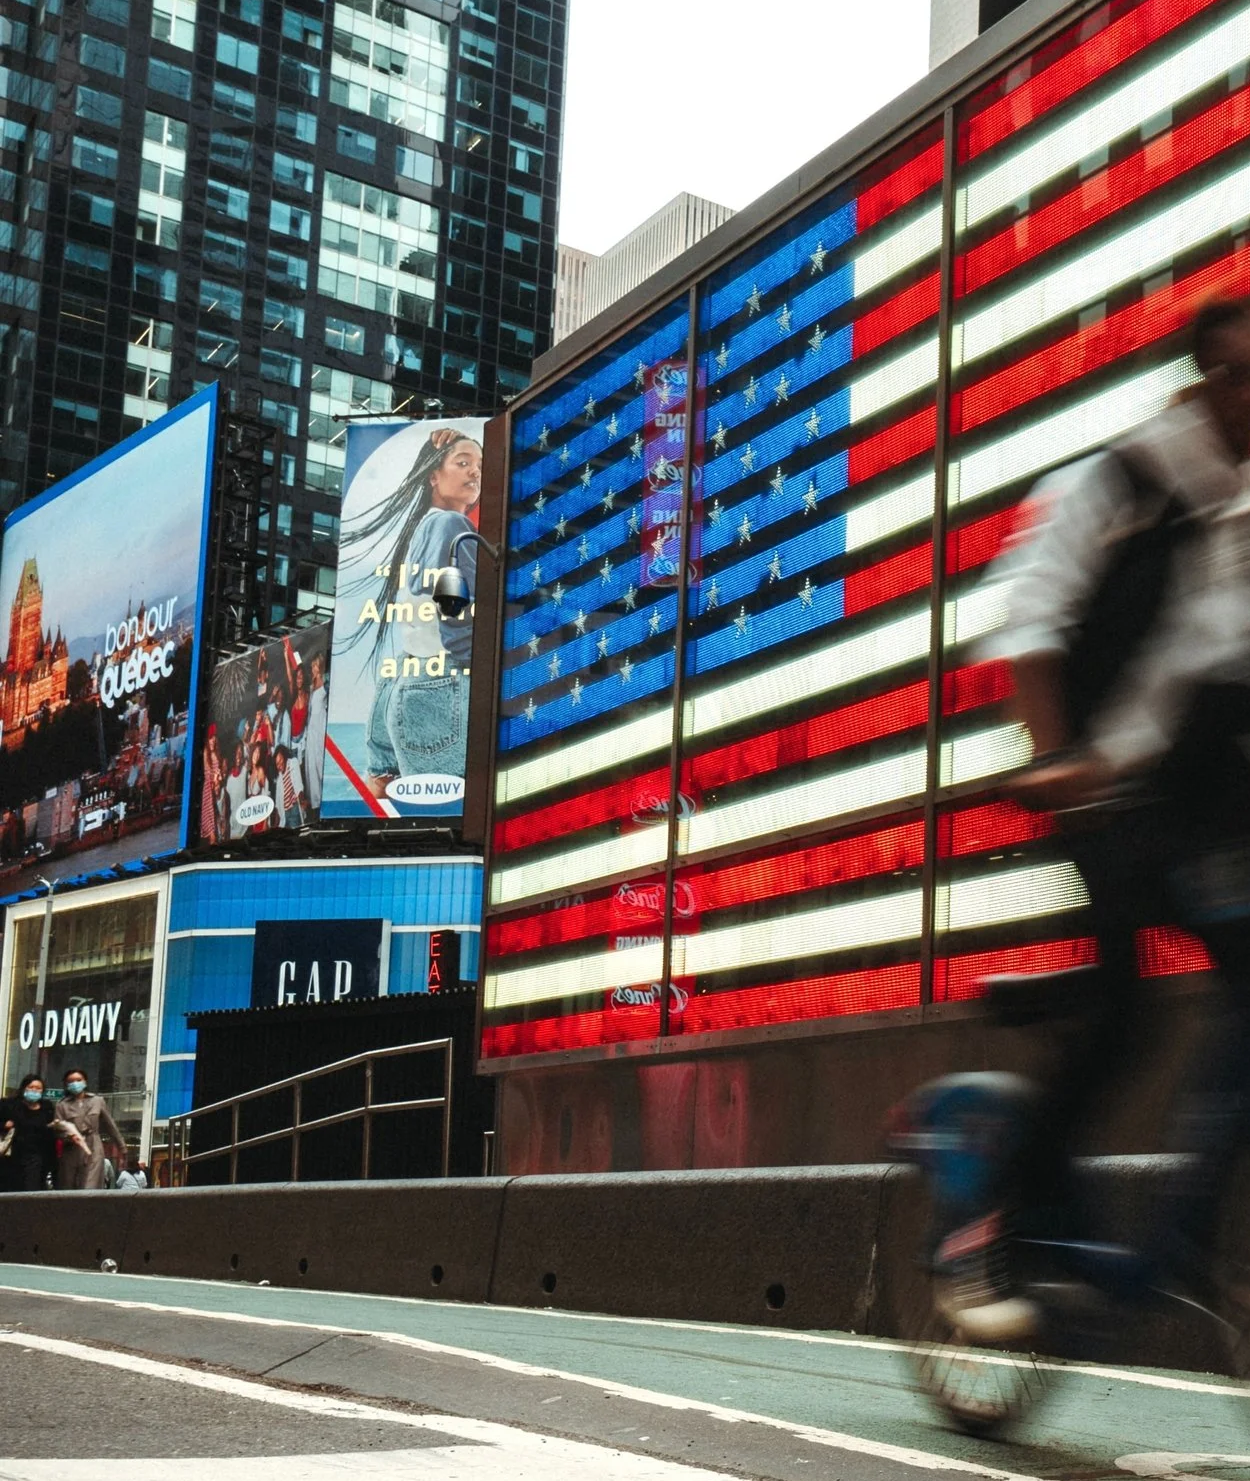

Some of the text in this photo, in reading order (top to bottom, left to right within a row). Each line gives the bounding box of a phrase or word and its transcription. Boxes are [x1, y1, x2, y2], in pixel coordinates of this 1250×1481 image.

[104, 594, 179, 658] bonjour
[357, 598, 475, 624] Ame
[396, 782, 461, 796] OLD NAVY
[240, 801, 270, 820] OLD NAVY
[276, 960, 353, 1007] GAP
[19, 1001, 121, 1050] OD NAVY
